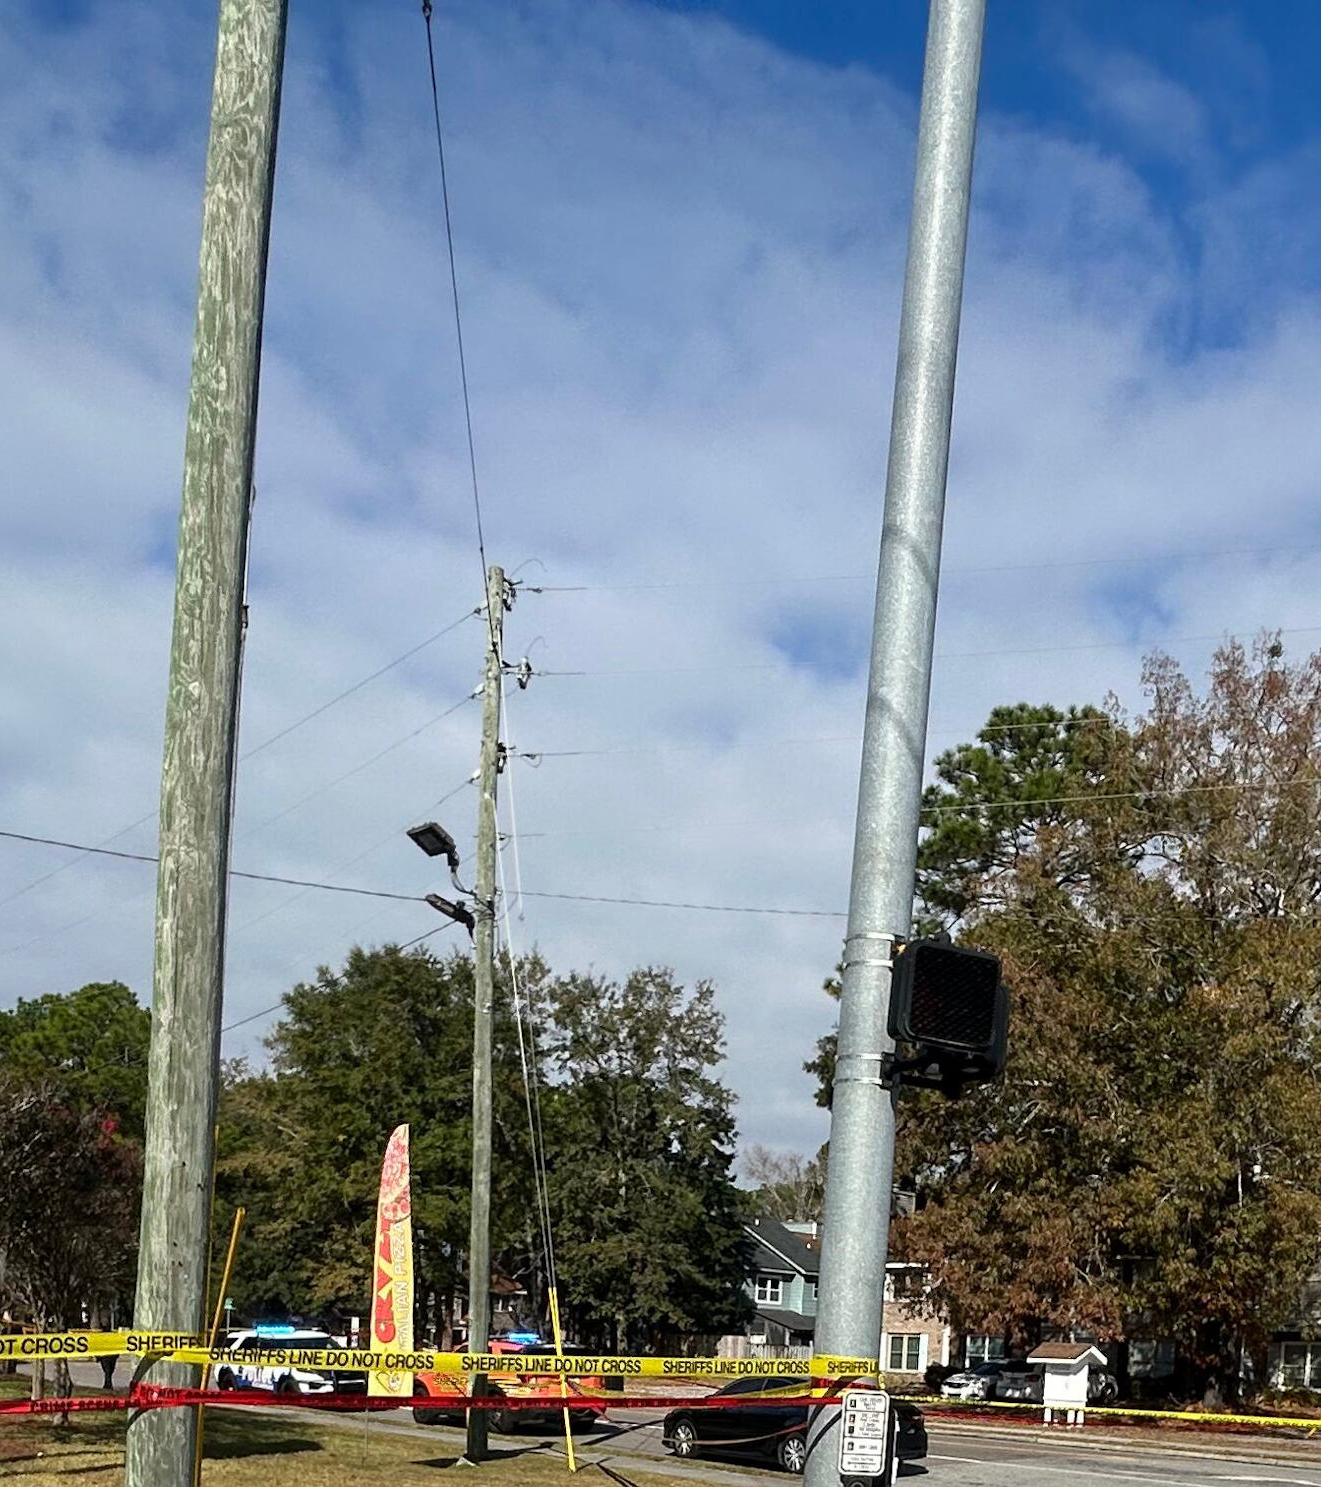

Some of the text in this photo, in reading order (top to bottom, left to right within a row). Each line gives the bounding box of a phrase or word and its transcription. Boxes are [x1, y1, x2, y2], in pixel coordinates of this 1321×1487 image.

[391, 1222, 408, 1276] PIZZA
[20, 1335, 89, 1354] CROSS
[210, 1347, 435, 1370] SHERIFFS LINE DO NOT CROSS
[461, 1356, 642, 1373] SHERIFFS LINE DO NOT CROSS
[663, 1360, 810, 1374] SHERIFFS LINE DO NOT CROSS
[827, 1360, 869, 1374] SHERIFFS
